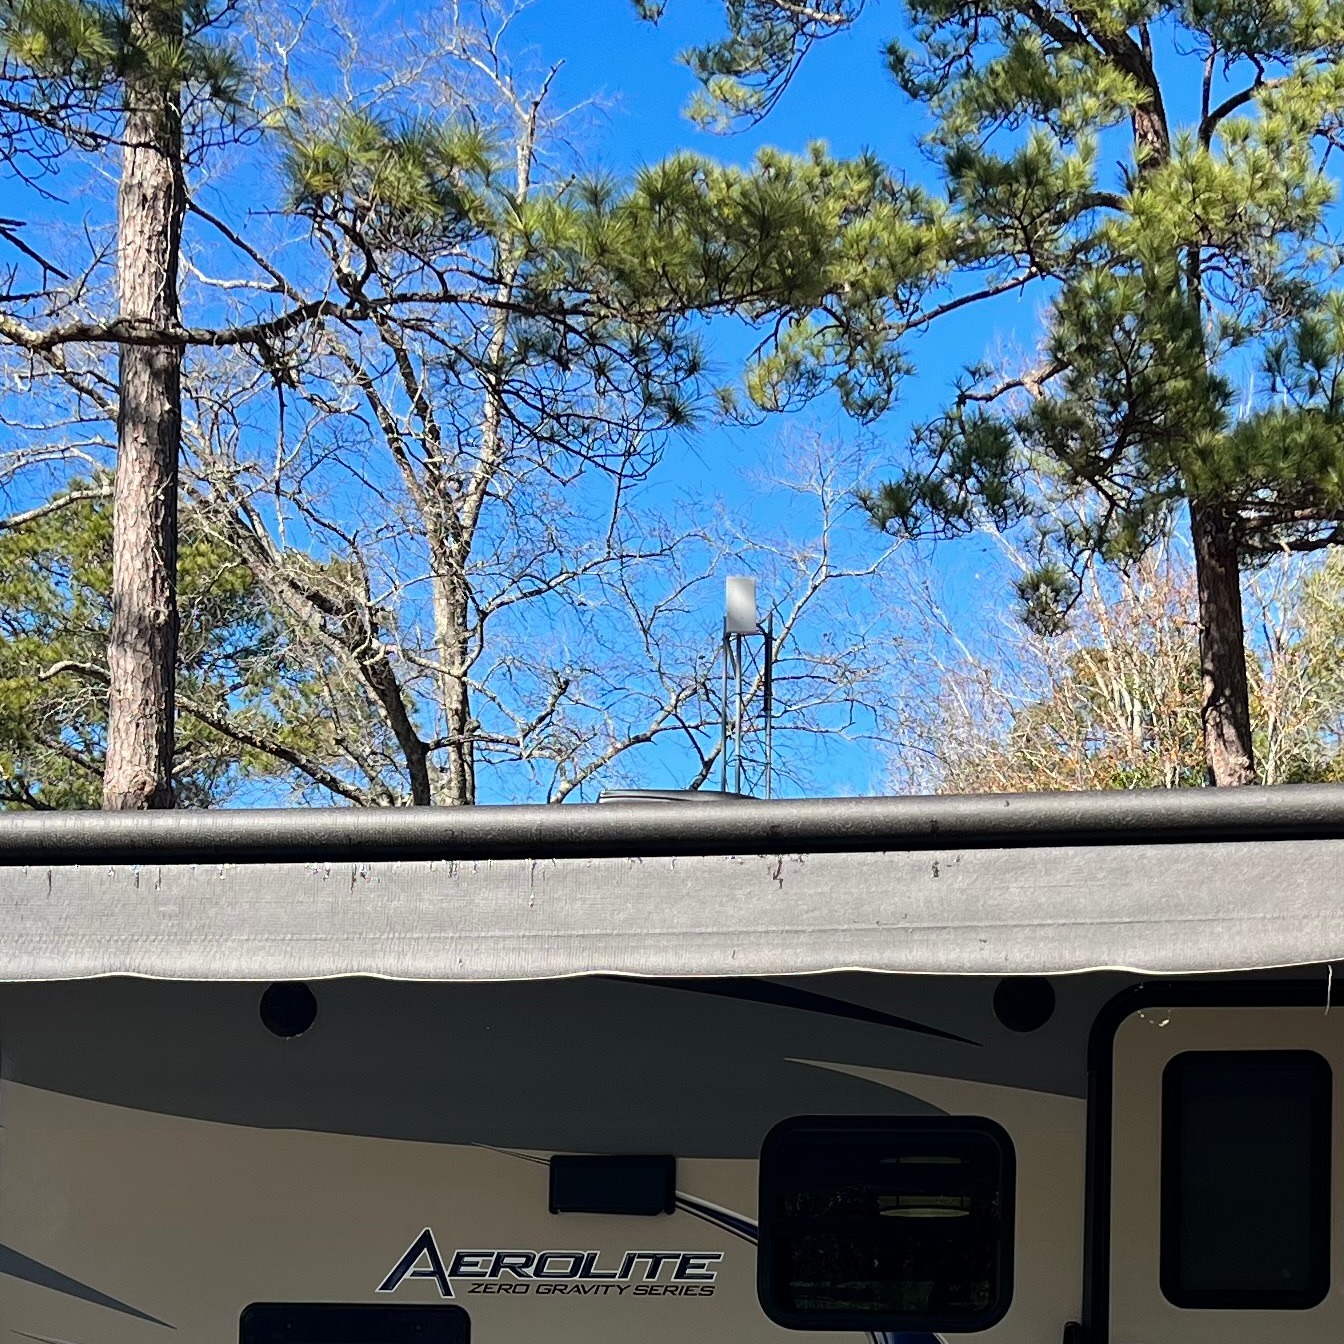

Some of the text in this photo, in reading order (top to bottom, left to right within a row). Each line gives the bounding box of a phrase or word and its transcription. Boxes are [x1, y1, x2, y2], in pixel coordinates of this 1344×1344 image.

[375, 1227, 726, 1298] AEROLITE
[467, 1282, 715, 1297] ZERO GRAVITY SERIES
